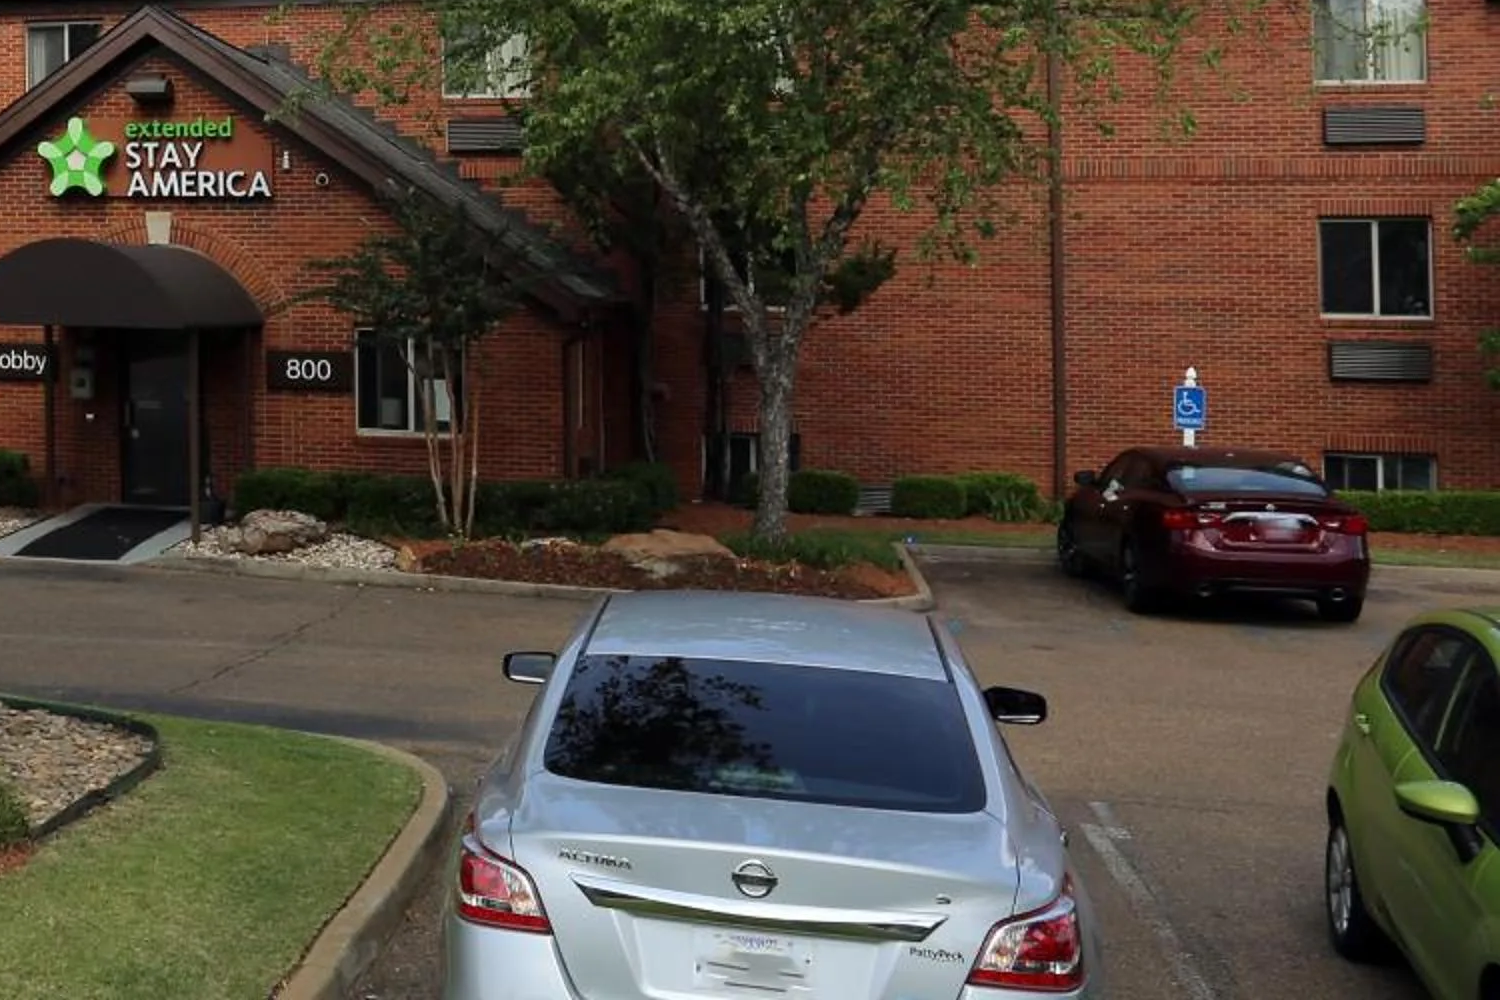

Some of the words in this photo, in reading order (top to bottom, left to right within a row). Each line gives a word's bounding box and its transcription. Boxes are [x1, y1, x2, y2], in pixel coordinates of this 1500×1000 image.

[125, 115, 232, 138] extended
[125, 141, 203, 169] STAY
[127, 171, 272, 197] AMERICA
[285, 358, 332, 381] 800
